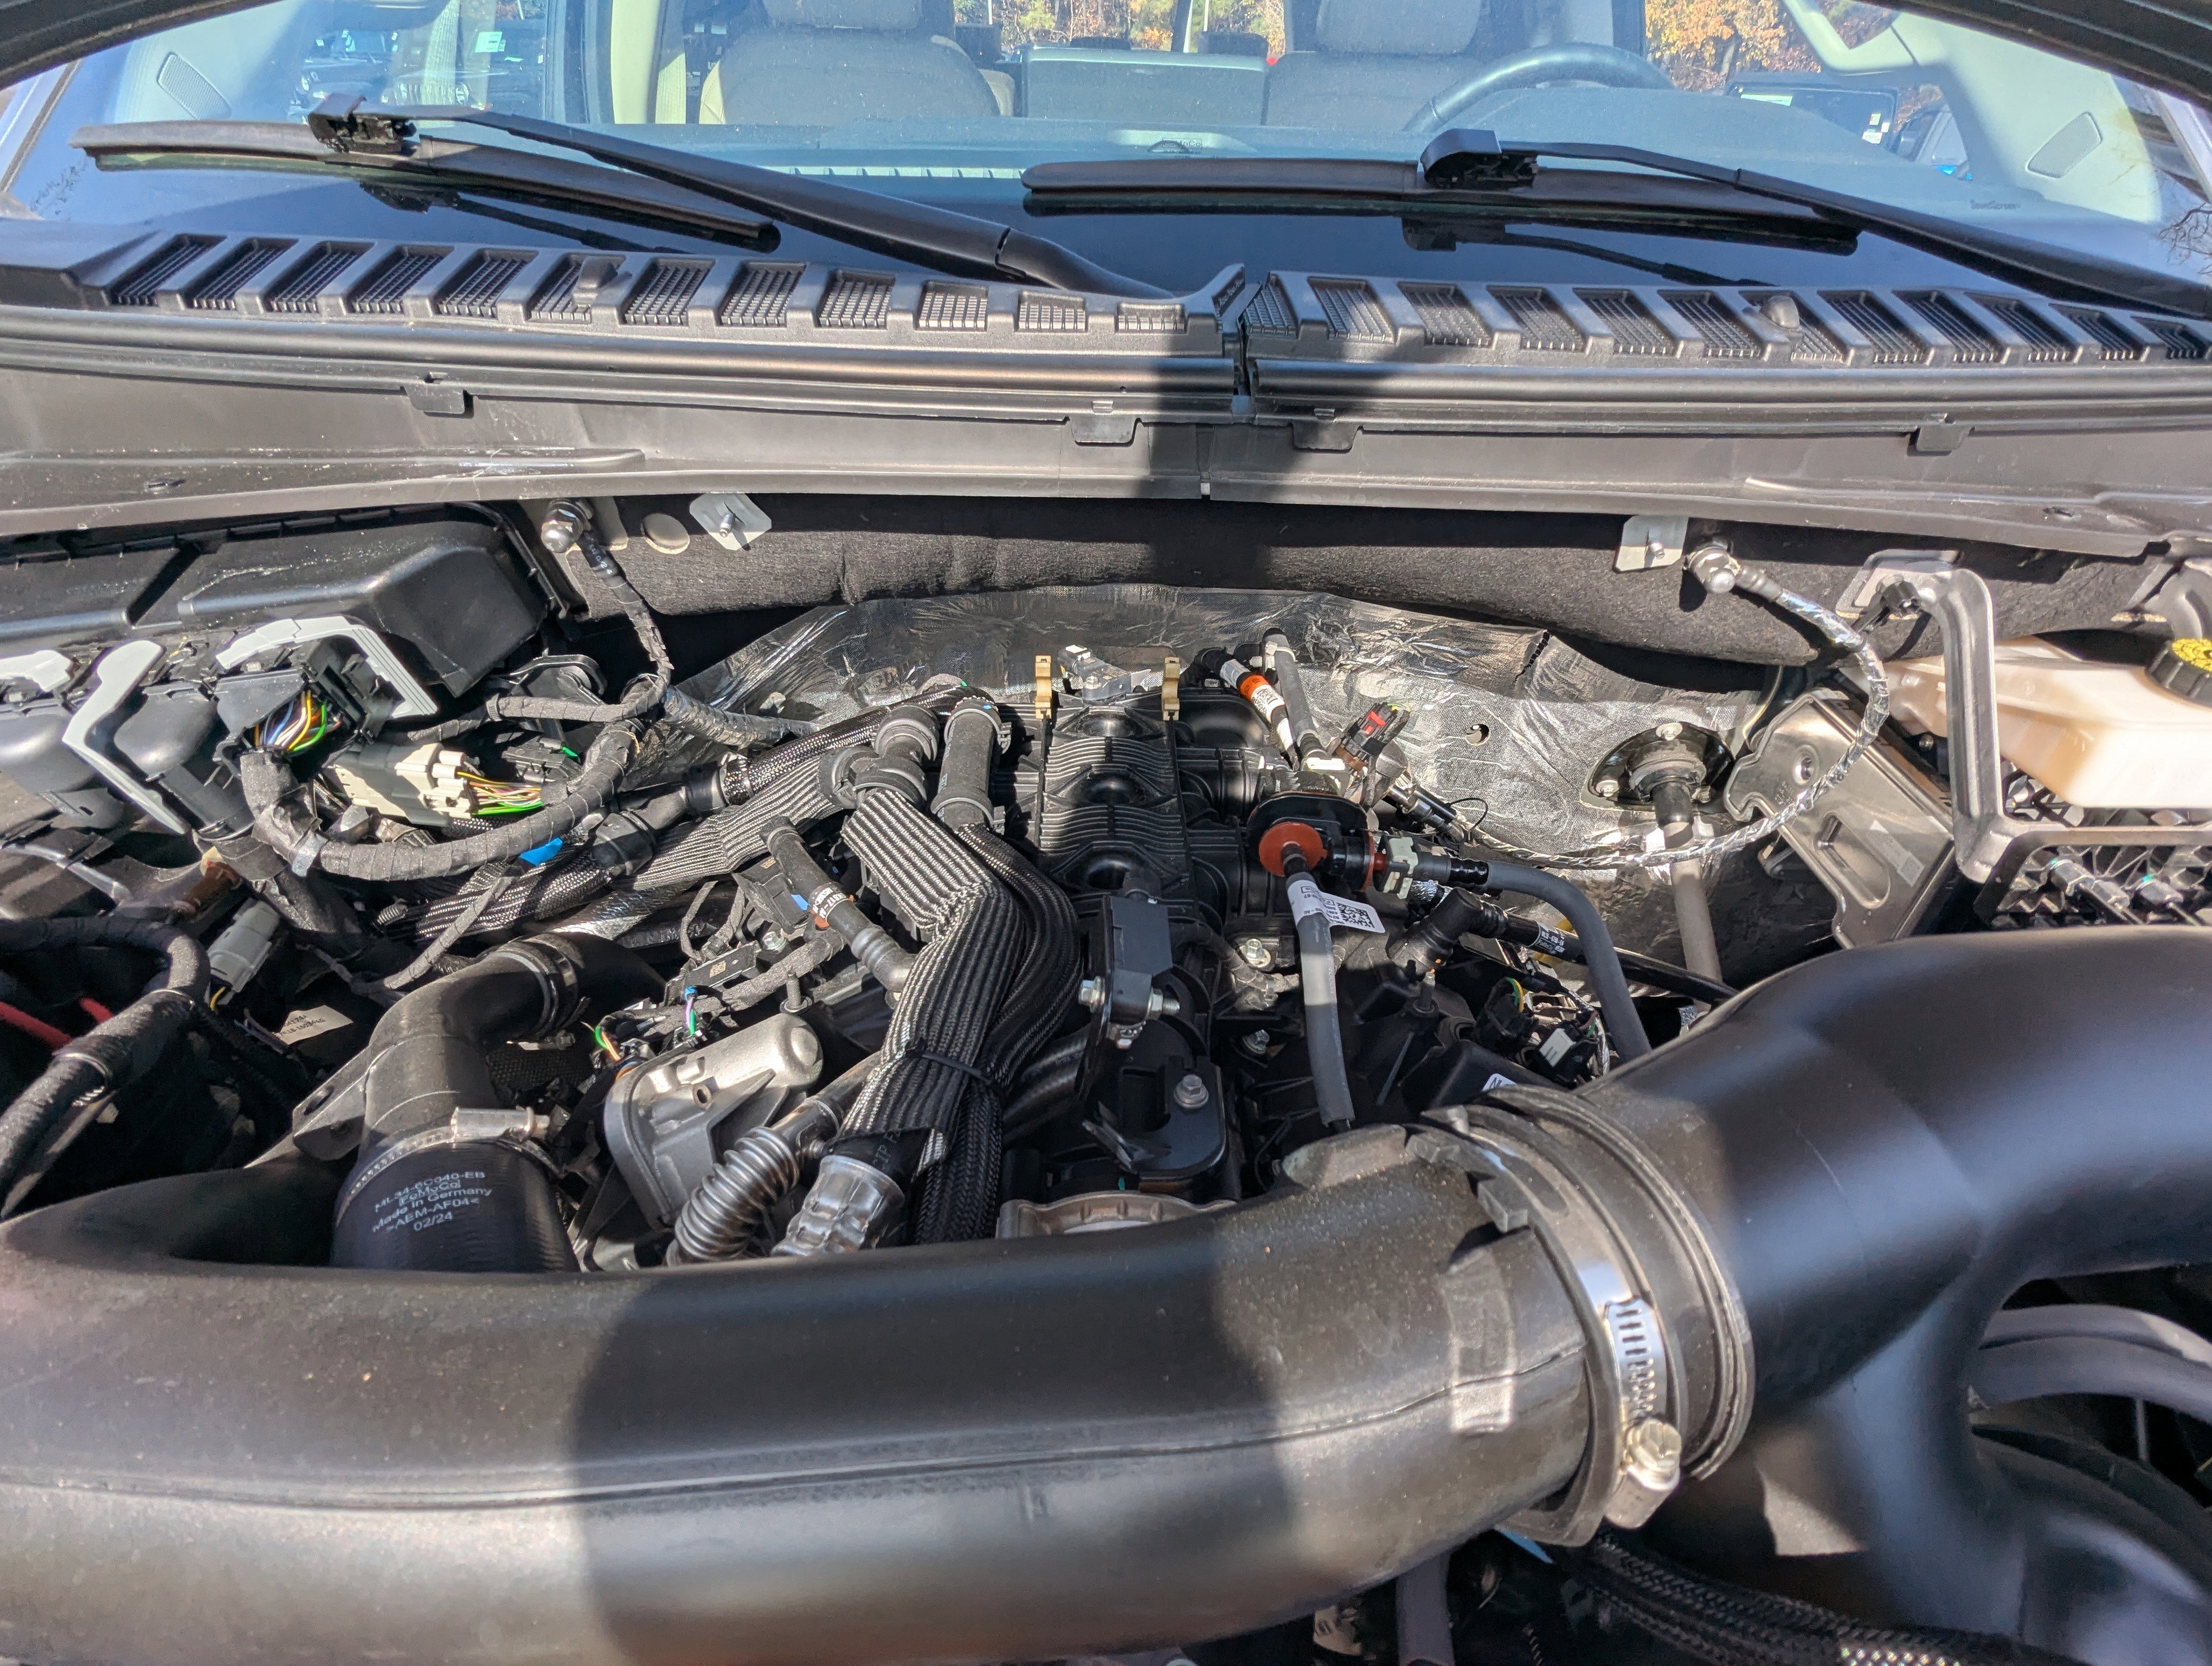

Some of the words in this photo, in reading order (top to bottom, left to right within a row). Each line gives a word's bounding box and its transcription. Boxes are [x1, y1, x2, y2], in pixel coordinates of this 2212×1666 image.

[372, 1206, 408, 1233] Made
[411, 1199, 423, 1208] in
[427, 1188, 492, 1202] Germany
[413, 1211, 453, 1232] 02/24
